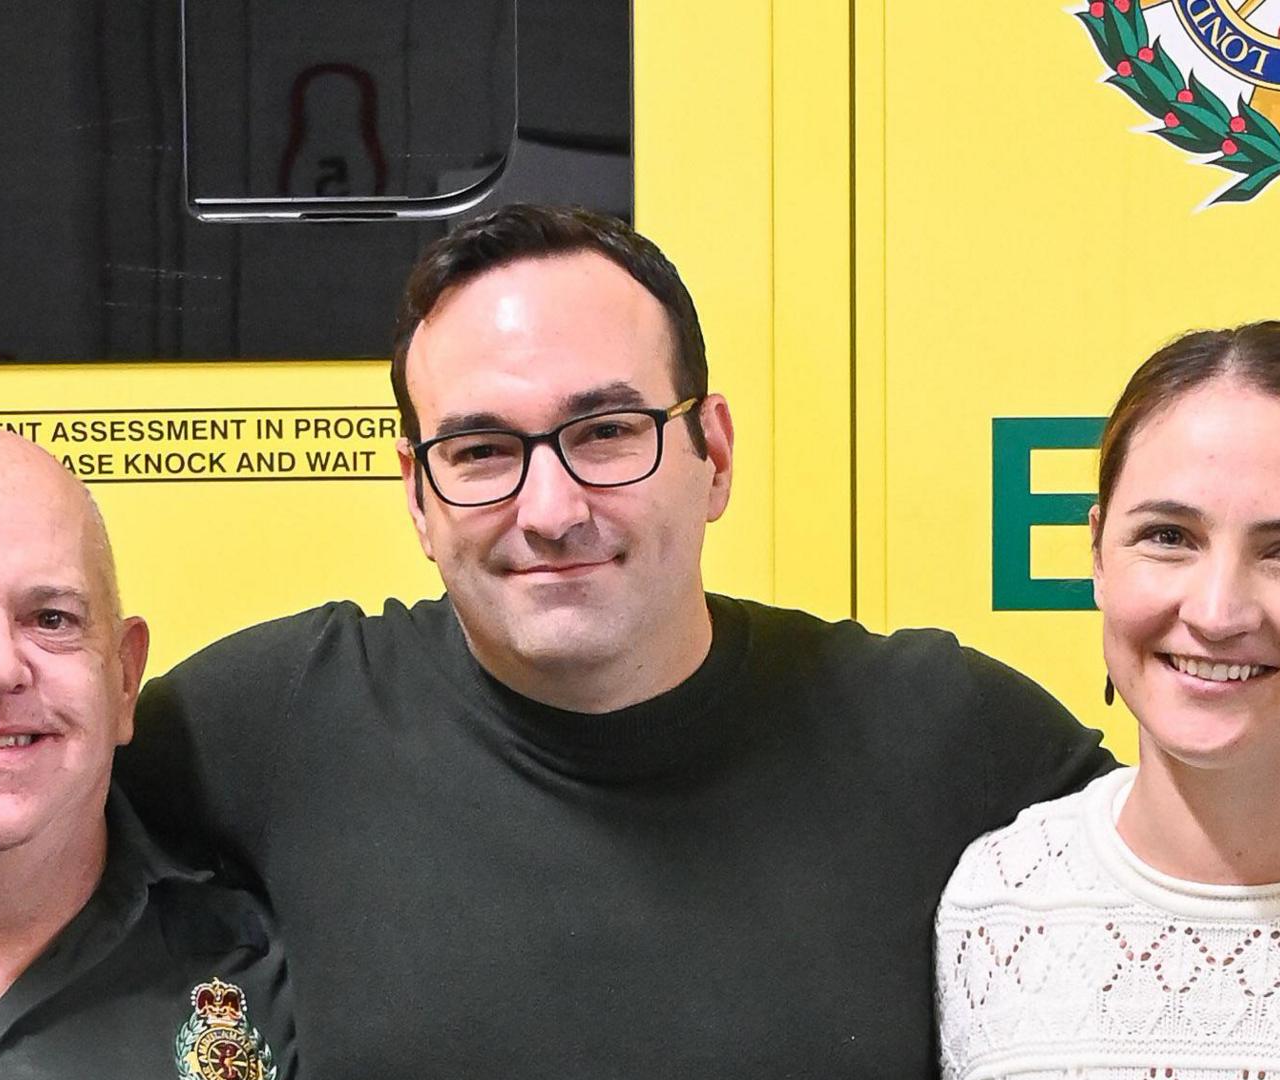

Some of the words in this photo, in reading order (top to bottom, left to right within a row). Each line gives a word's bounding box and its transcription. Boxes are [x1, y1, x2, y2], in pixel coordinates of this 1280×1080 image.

[1186, 0, 1270, 76] LOND
[51, 419, 247, 443] ASSESSMENT
[256, 418, 283, 440] IN
[295, 417, 397, 439] PROGR
[61, 453, 115, 475] ASE
[124, 453, 225, 475] KNOCK
[236, 451, 296, 473] AND
[306, 450, 377, 472] WAIT
